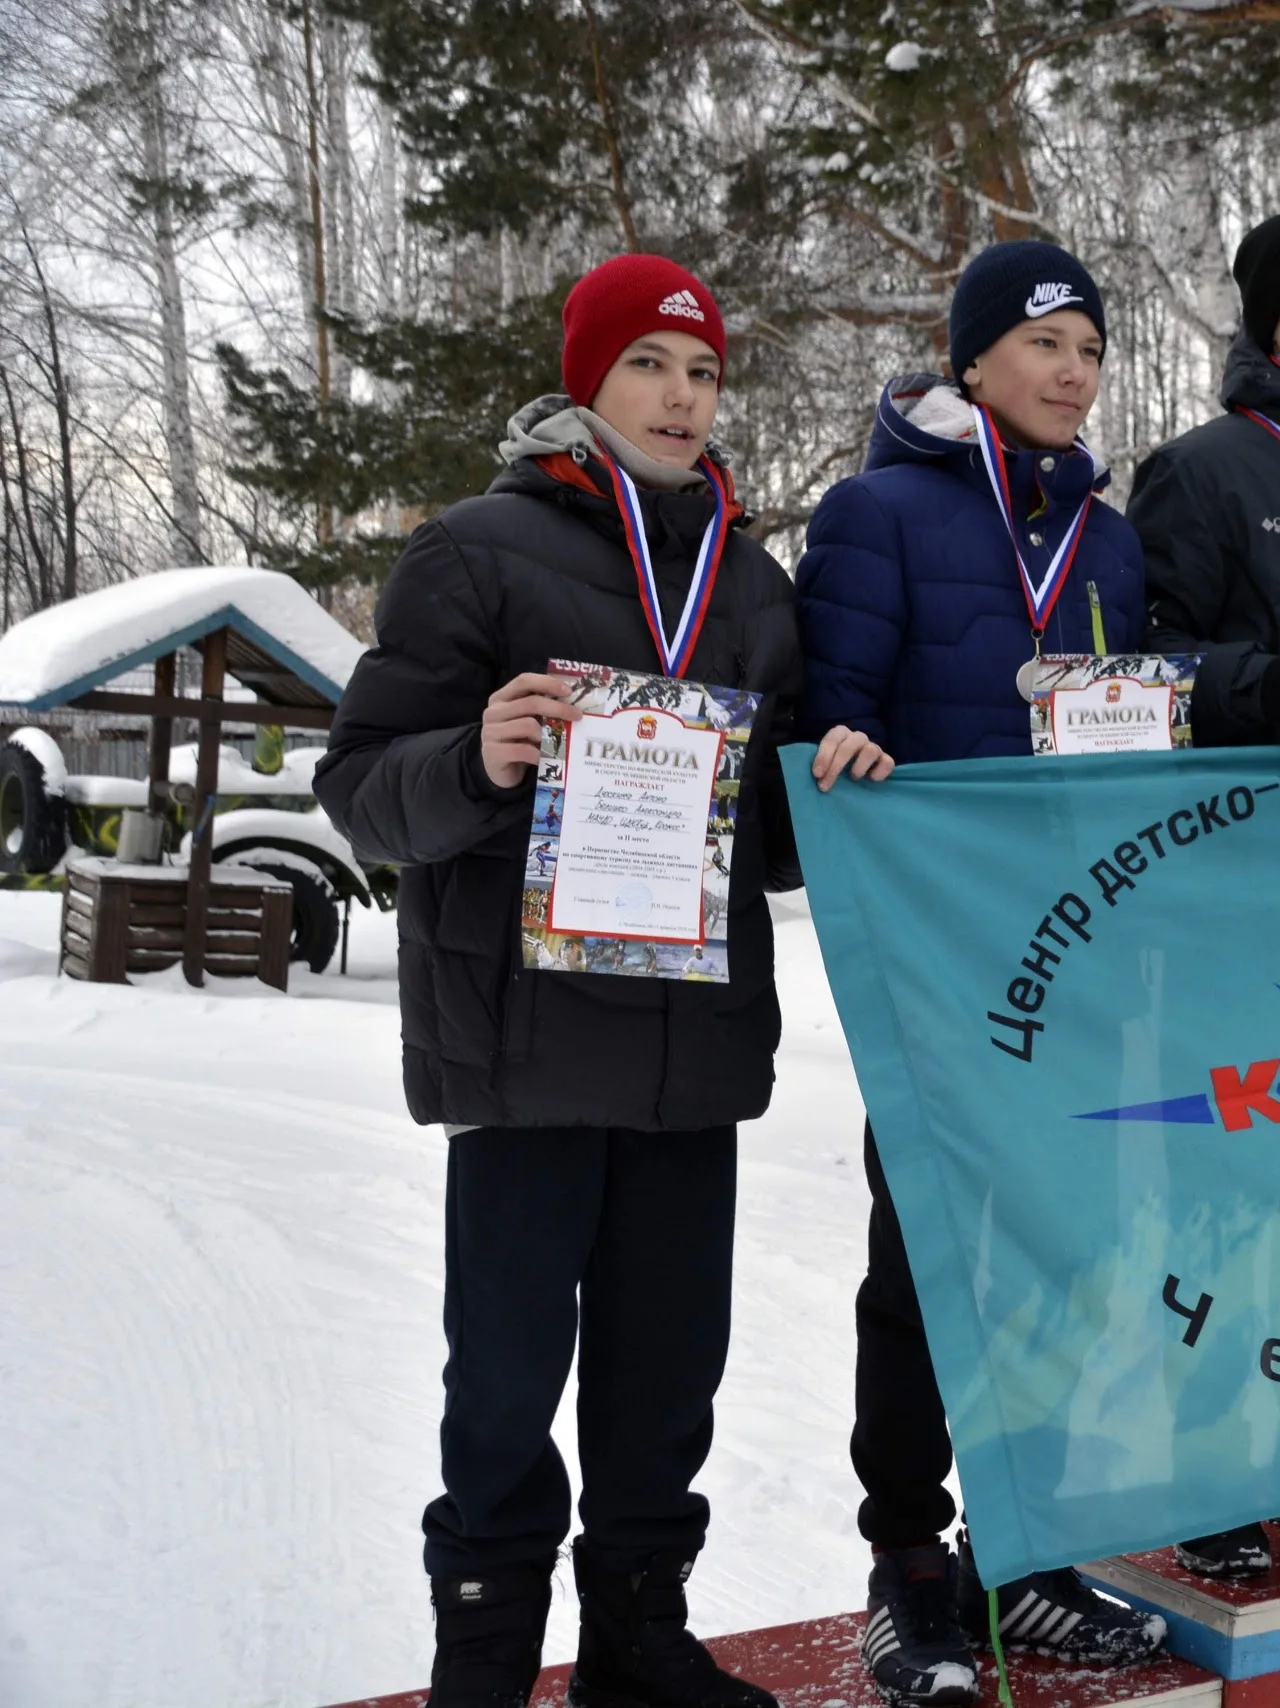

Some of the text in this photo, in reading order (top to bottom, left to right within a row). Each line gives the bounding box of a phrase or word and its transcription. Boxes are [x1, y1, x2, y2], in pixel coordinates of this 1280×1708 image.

[1033, 282, 1072, 304] NIKE
[658, 303, 705, 322] adidas
[1067, 705, 1158, 726] ГРАМОТА
[585, 737, 699, 771] ГРАМОТА
[614, 779, 664, 791] НАГРАЖДАЕТ
[987, 893, 1092, 1062] Центр
